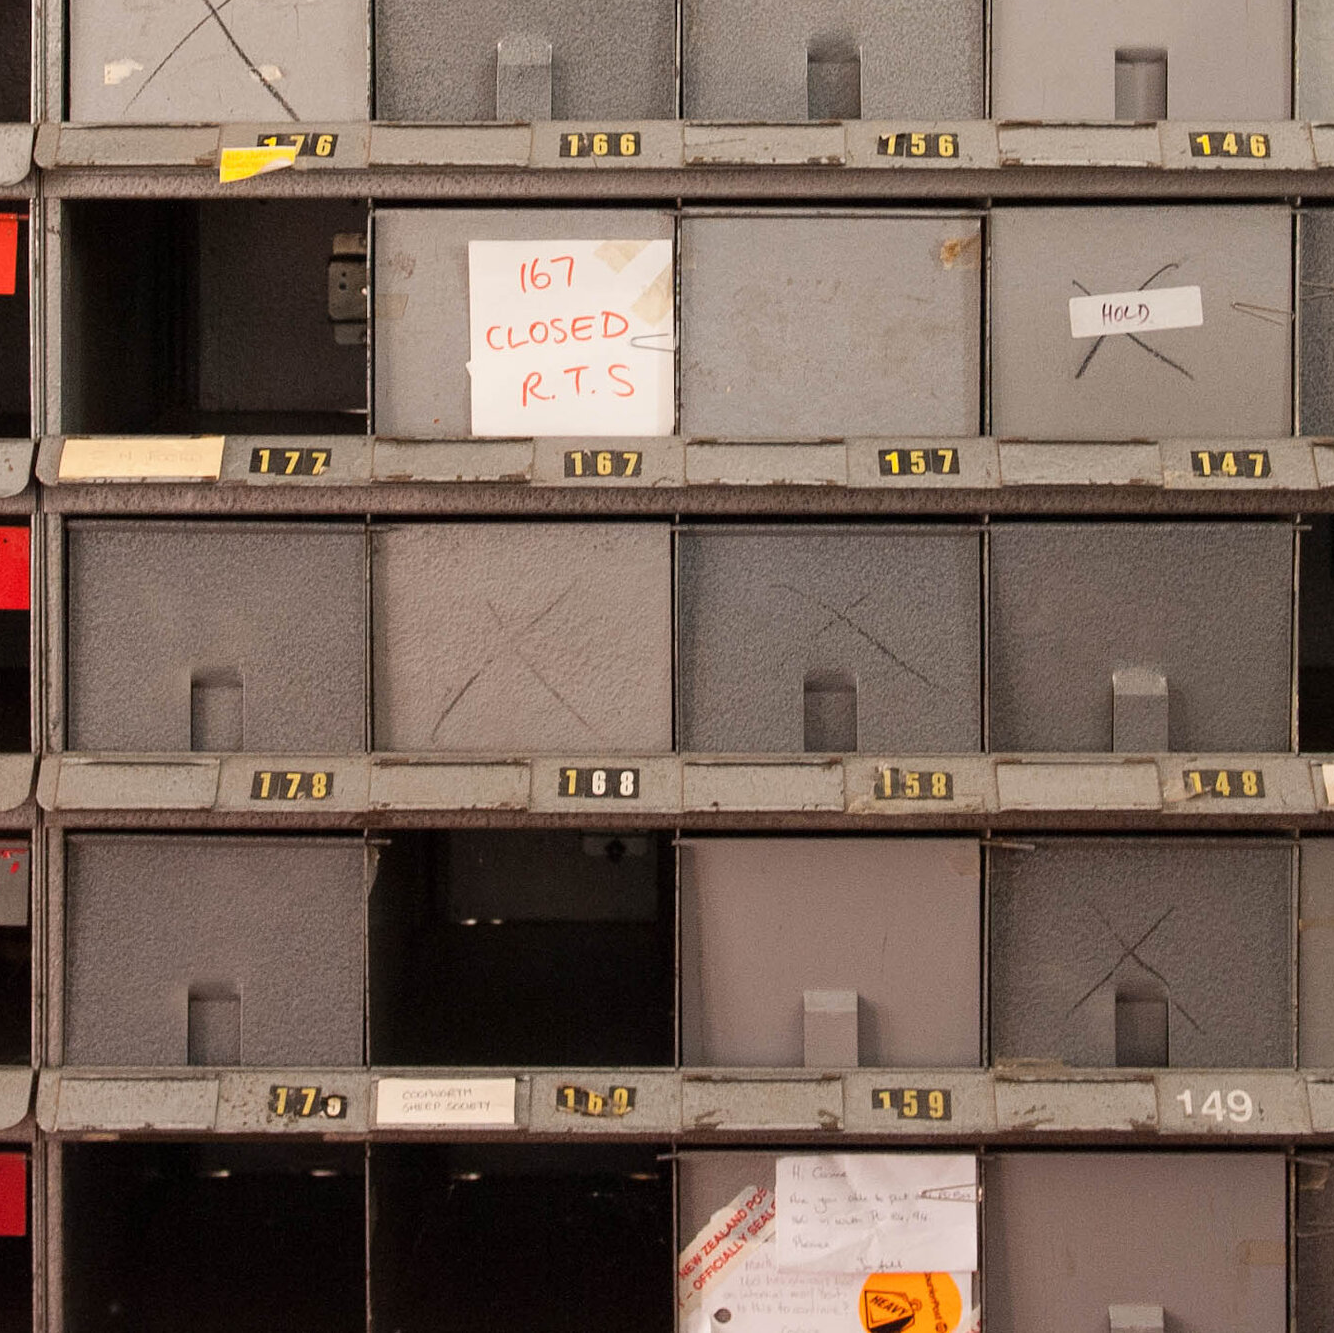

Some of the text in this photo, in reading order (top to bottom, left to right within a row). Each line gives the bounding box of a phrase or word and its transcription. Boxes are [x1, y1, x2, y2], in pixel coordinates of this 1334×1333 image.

[568, 132, 635, 157] 166
[887, 132, 954, 157] 156
[1195, 131, 1266, 158] 146
[518, 255, 574, 293] 167
[1101, 302, 1150, 325] HOLD
[485, 310, 630, 352] CLOSED
[259, 449, 327, 477] 177
[571, 451, 638, 477] 167
[885, 449, 953, 474] 157
[1198, 451, 1263, 477] 147
[260, 772, 327, 799] 178
[565, 769, 636, 798] 168
[883, 769, 946, 797] 158
[1189, 769, 1258, 796] 148
[879, 1089, 944, 1118] 159
[1176, 1088, 1253, 1122] 149
[701, 1208, 749, 1257] ZEALAND
[693, 1234, 749, 1292] OFFICIALLY
[871, 1295, 908, 1317] HEAVY
